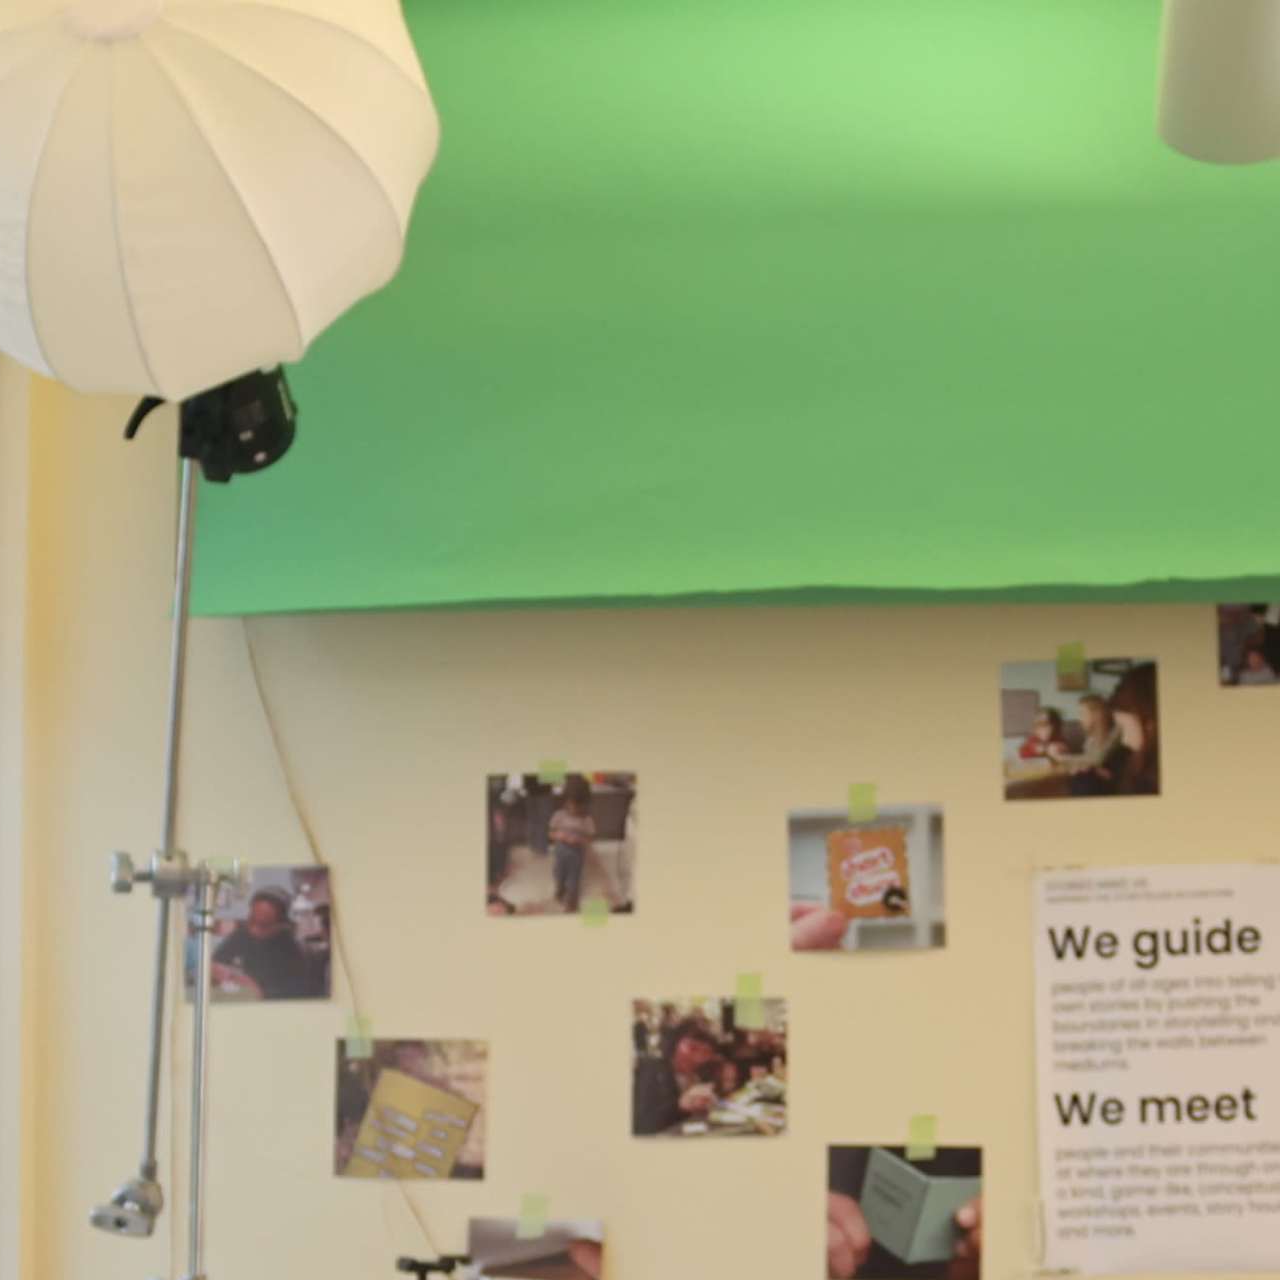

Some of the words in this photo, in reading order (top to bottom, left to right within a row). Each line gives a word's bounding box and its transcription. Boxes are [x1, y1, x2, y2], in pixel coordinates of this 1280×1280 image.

[1048, 925, 1120, 962] We
[1131, 916, 1262, 971] guide
[1053, 1092, 1126, 1127] We
[1138, 1086, 1258, 1125] meet
